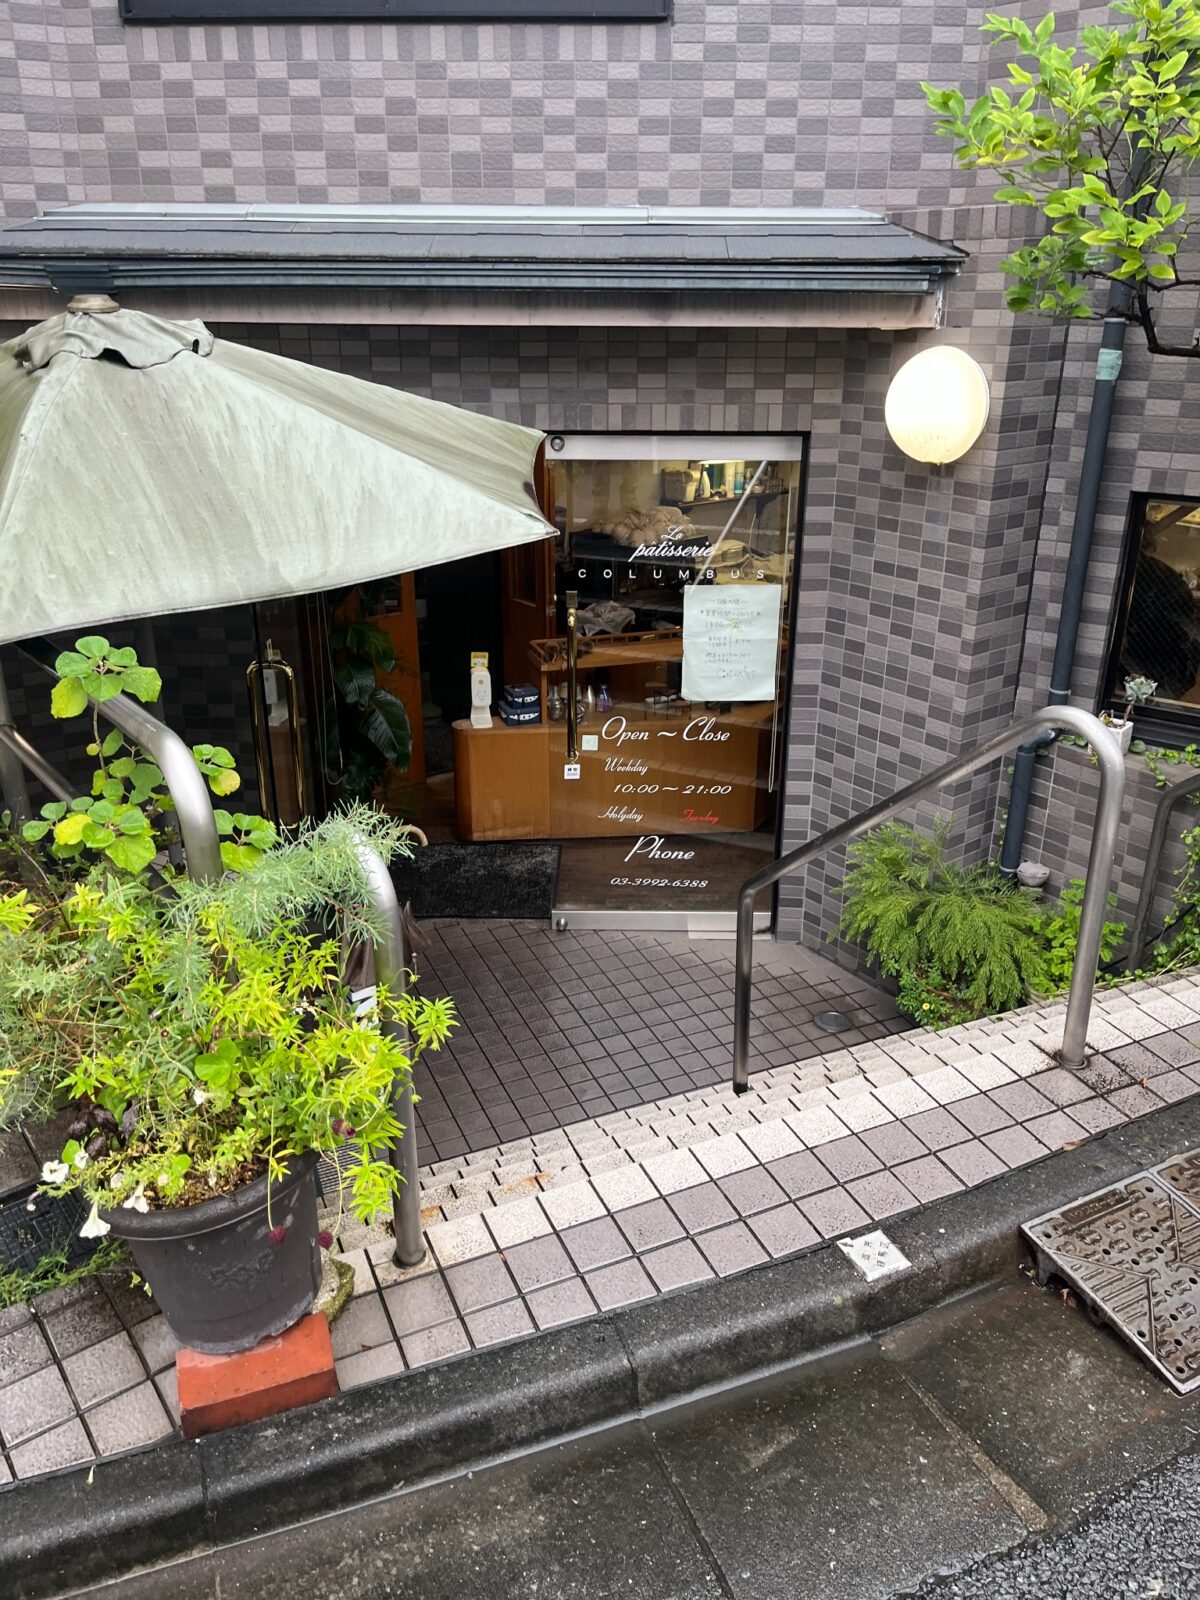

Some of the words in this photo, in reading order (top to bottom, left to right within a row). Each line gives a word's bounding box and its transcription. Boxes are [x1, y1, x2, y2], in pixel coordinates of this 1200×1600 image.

[661, 525, 684, 541] La
[628, 541, 714, 563] pâtisserie
[577, 568, 766, 580] COLUMBUS
[601, 716, 650, 747] Open
[682, 716, 731, 742] Close
[605, 757, 648, 776] Weekday
[613, 784, 660, 794] 10:00
[681, 784, 732, 795] 21:00
[597, 806, 644, 823] Holyday
[683, 809, 719, 825] Tuesday
[624, 835, 695, 863] Phone
[610, 877, 709, 889] 03-3992-6388
